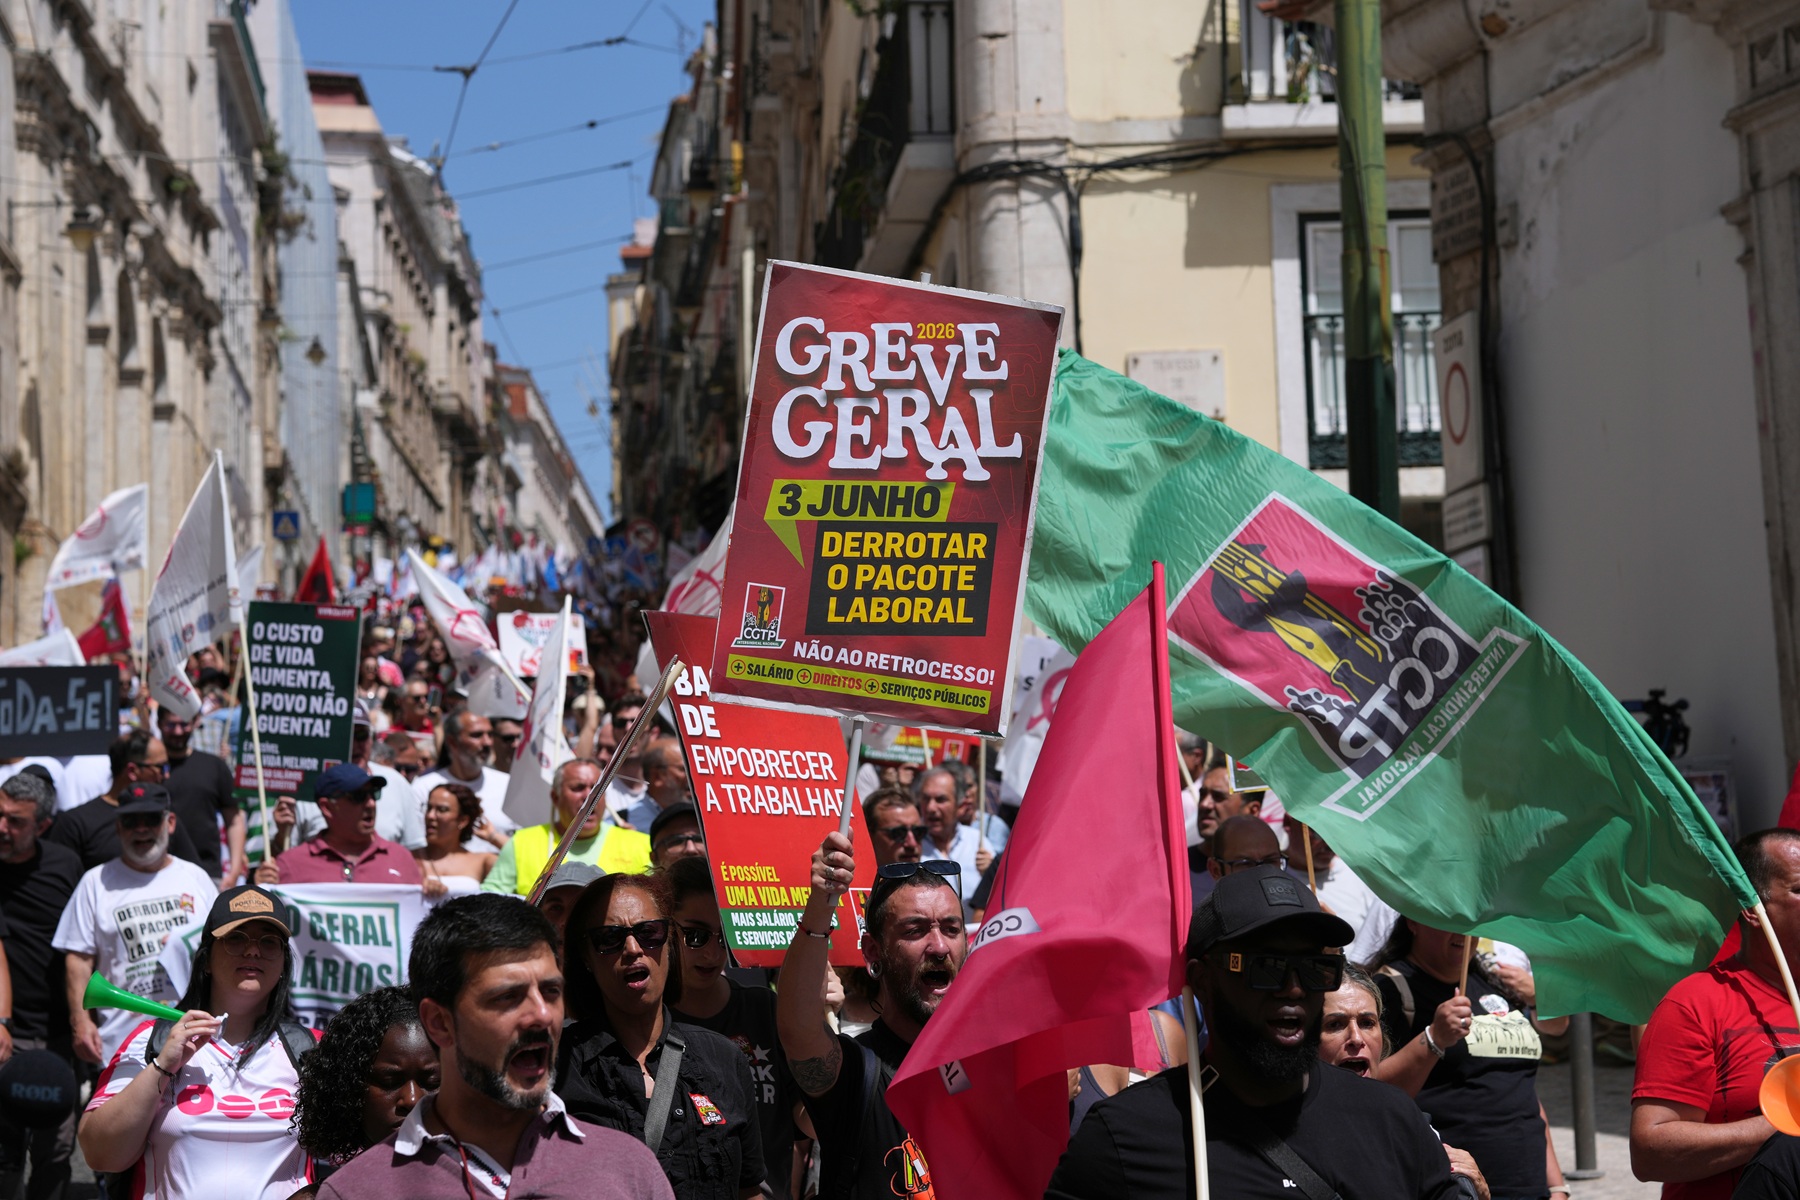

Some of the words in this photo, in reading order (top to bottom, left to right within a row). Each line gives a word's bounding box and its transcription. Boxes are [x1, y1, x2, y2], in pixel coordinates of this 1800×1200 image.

[916, 322, 956, 340] 2026
[775, 316, 1009, 406] GREVE
[771, 386, 1023, 482] GERAL
[777, 483, 802, 517] 3
[806, 484, 942, 519] JUNHO
[821, 531, 988, 560] DERROTAR
[827, 564, 849, 590] O
[855, 563, 977, 591] PACOTE
[827, 596, 975, 625] LABORAL
[252, 621, 265, 640] O
[266, 622, 324, 645] CUSTO
[743, 627, 777, 641] CGTP
[249, 643, 273, 664] DE
[274, 645, 316, 667] VIDA
[793, 639, 834, 662] NÃO
[834, 647, 863, 667] AO
[864, 652, 996, 686] RETROCESSO!
[250, 665, 335, 692] AUMENTA,
[746, 662, 794, 681] SALÁRIO
[812, 671, 863, 691] DIREITOS
[880, 680, 933, 702] SERVIÇOS
[933, 685, 987, 709] PÚBLICOS
[261, 692, 308, 714] POVO
[308, 690, 348, 717] NÃO
[679, 703, 722, 738] DE
[690, 744, 838, 781] EMPOBRECER
[705, 782, 722, 812] A
[720, 862, 730, 882] É
[729, 862, 780, 882] POSSÍVEL
[234, 899, 269, 908] PORTUGAL
[725, 886, 756, 907] UMA
[758, 886, 791, 907] VIDA
[309, 911, 393, 947] GERAL
[731, 911, 755, 927] MAIS
[755, 908, 798, 928] SALÁRIO,
[123, 926, 134, 941] O
[735, 930, 742, 945] E
[741, 931, 786, 949] SERVIÇOS
